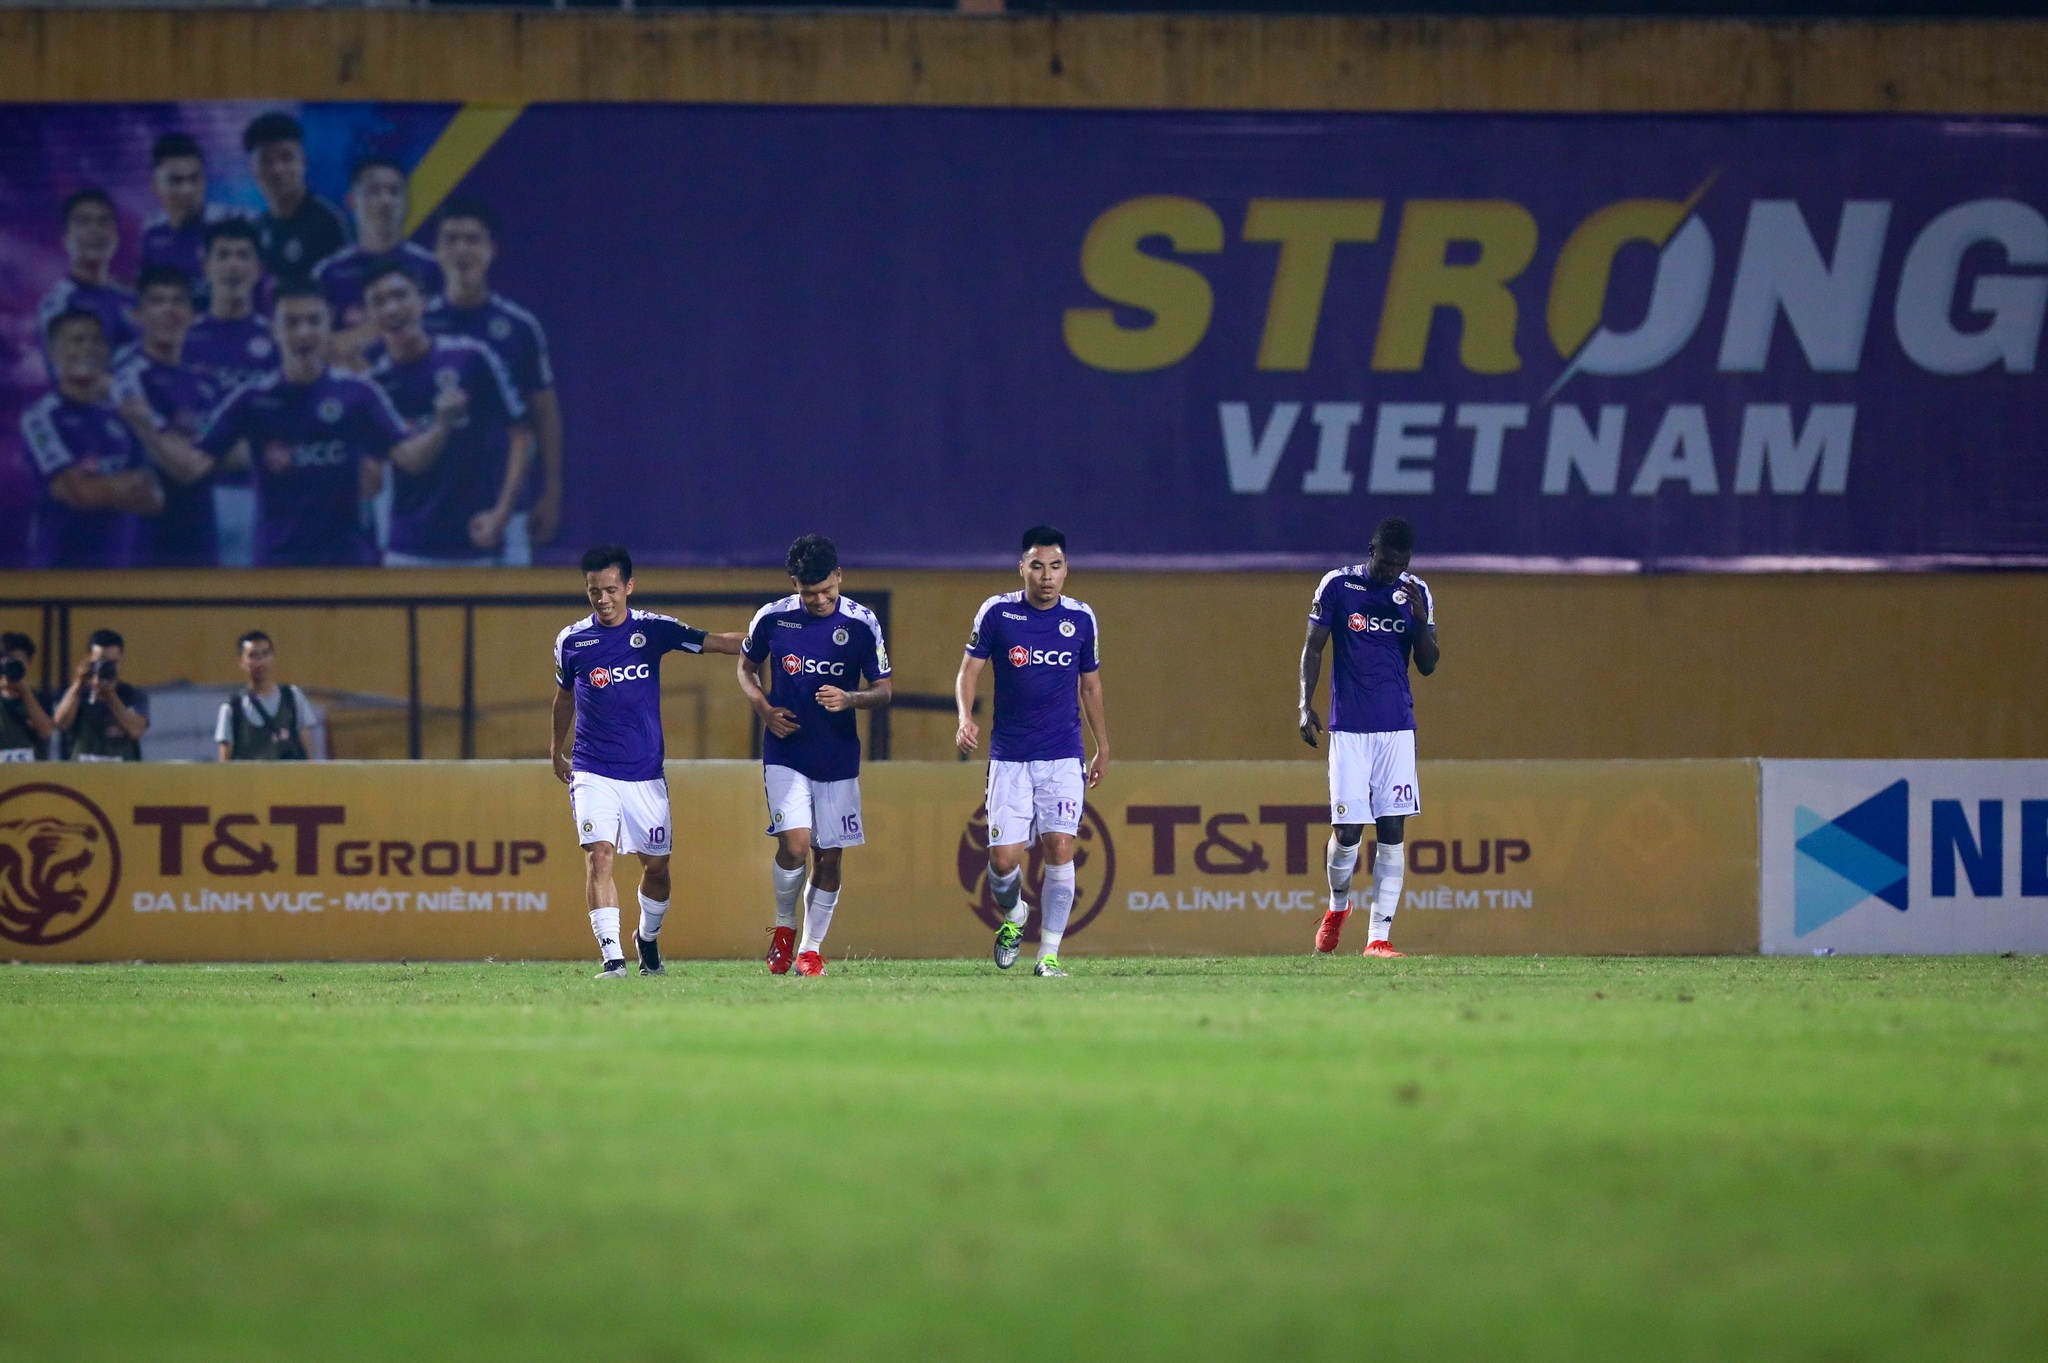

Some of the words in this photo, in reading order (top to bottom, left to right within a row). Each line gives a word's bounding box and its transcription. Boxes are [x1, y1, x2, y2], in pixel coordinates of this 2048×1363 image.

[1063, 195, 2048, 375] STRONG
[1219, 403, 1858, 496] VIETNAM
[1369, 617, 1406, 633] SCG
[805, 659, 844, 676] SCG
[1032, 649, 1072, 667] SCG
[612, 663, 649, 682] SCG
[1392, 784, 1413, 802] 20
[1057, 801, 1076, 820] 15
[841, 813, 859, 834] 16
[133, 805, 346, 877] T&T
[335, 840, 547, 877] GROUP
[648, 826, 665, 845] 10
[1127, 805, 1331, 876] T&T
[496, 891, 548, 913] TIN
[1484, 889, 1534, 909] TIN
